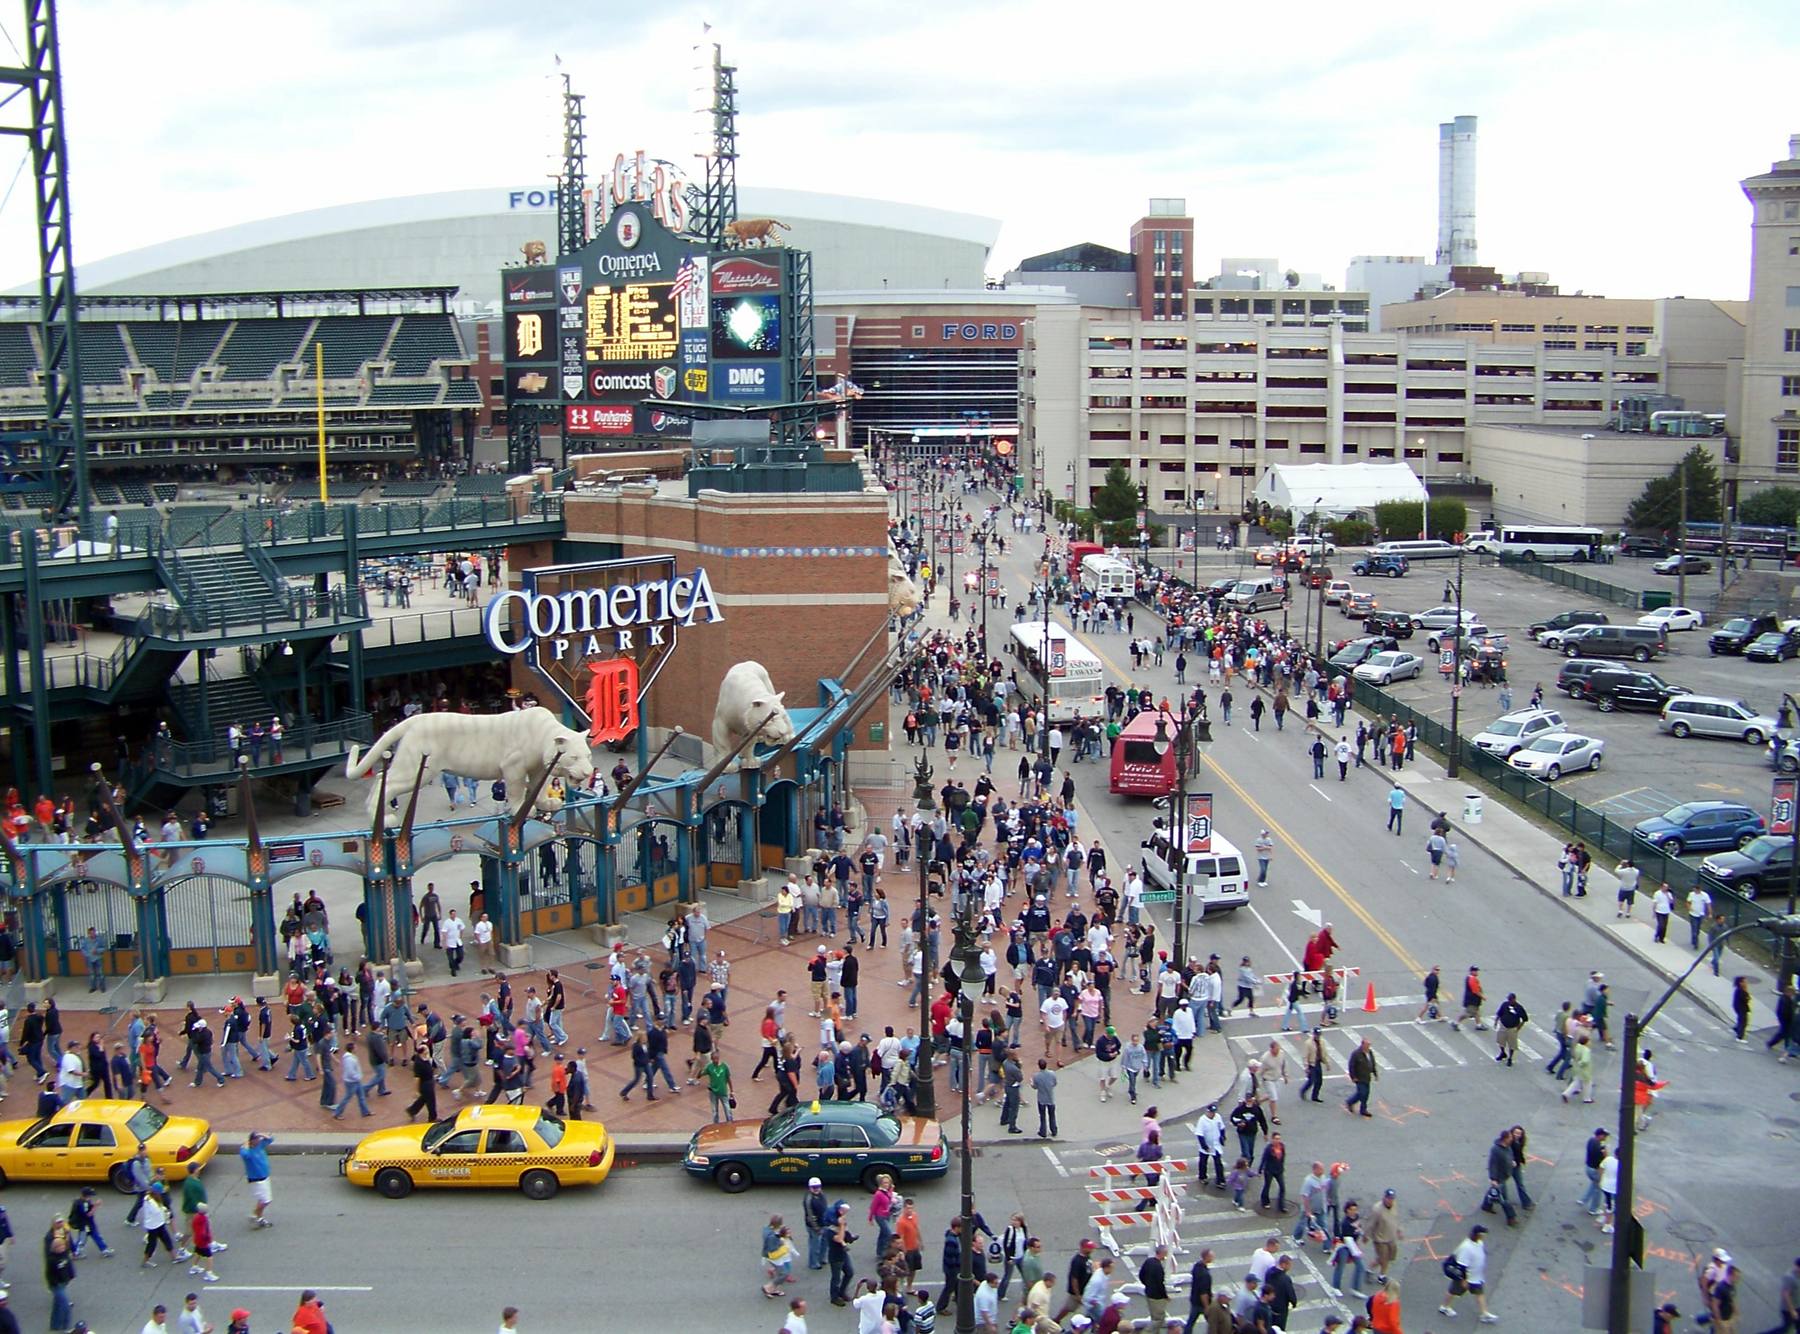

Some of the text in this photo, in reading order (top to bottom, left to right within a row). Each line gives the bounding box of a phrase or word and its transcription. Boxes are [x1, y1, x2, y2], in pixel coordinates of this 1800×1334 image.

[582, 150, 686, 240] TIGERS
[943, 324, 1016, 340] FORD
[594, 372, 652, 390] comcast
[729, 368, 765, 385] DMC
[554, 626, 665, 660] PARK
[586, 657, 640, 747] D
[430, 1167, 471, 1177] CHECKER
